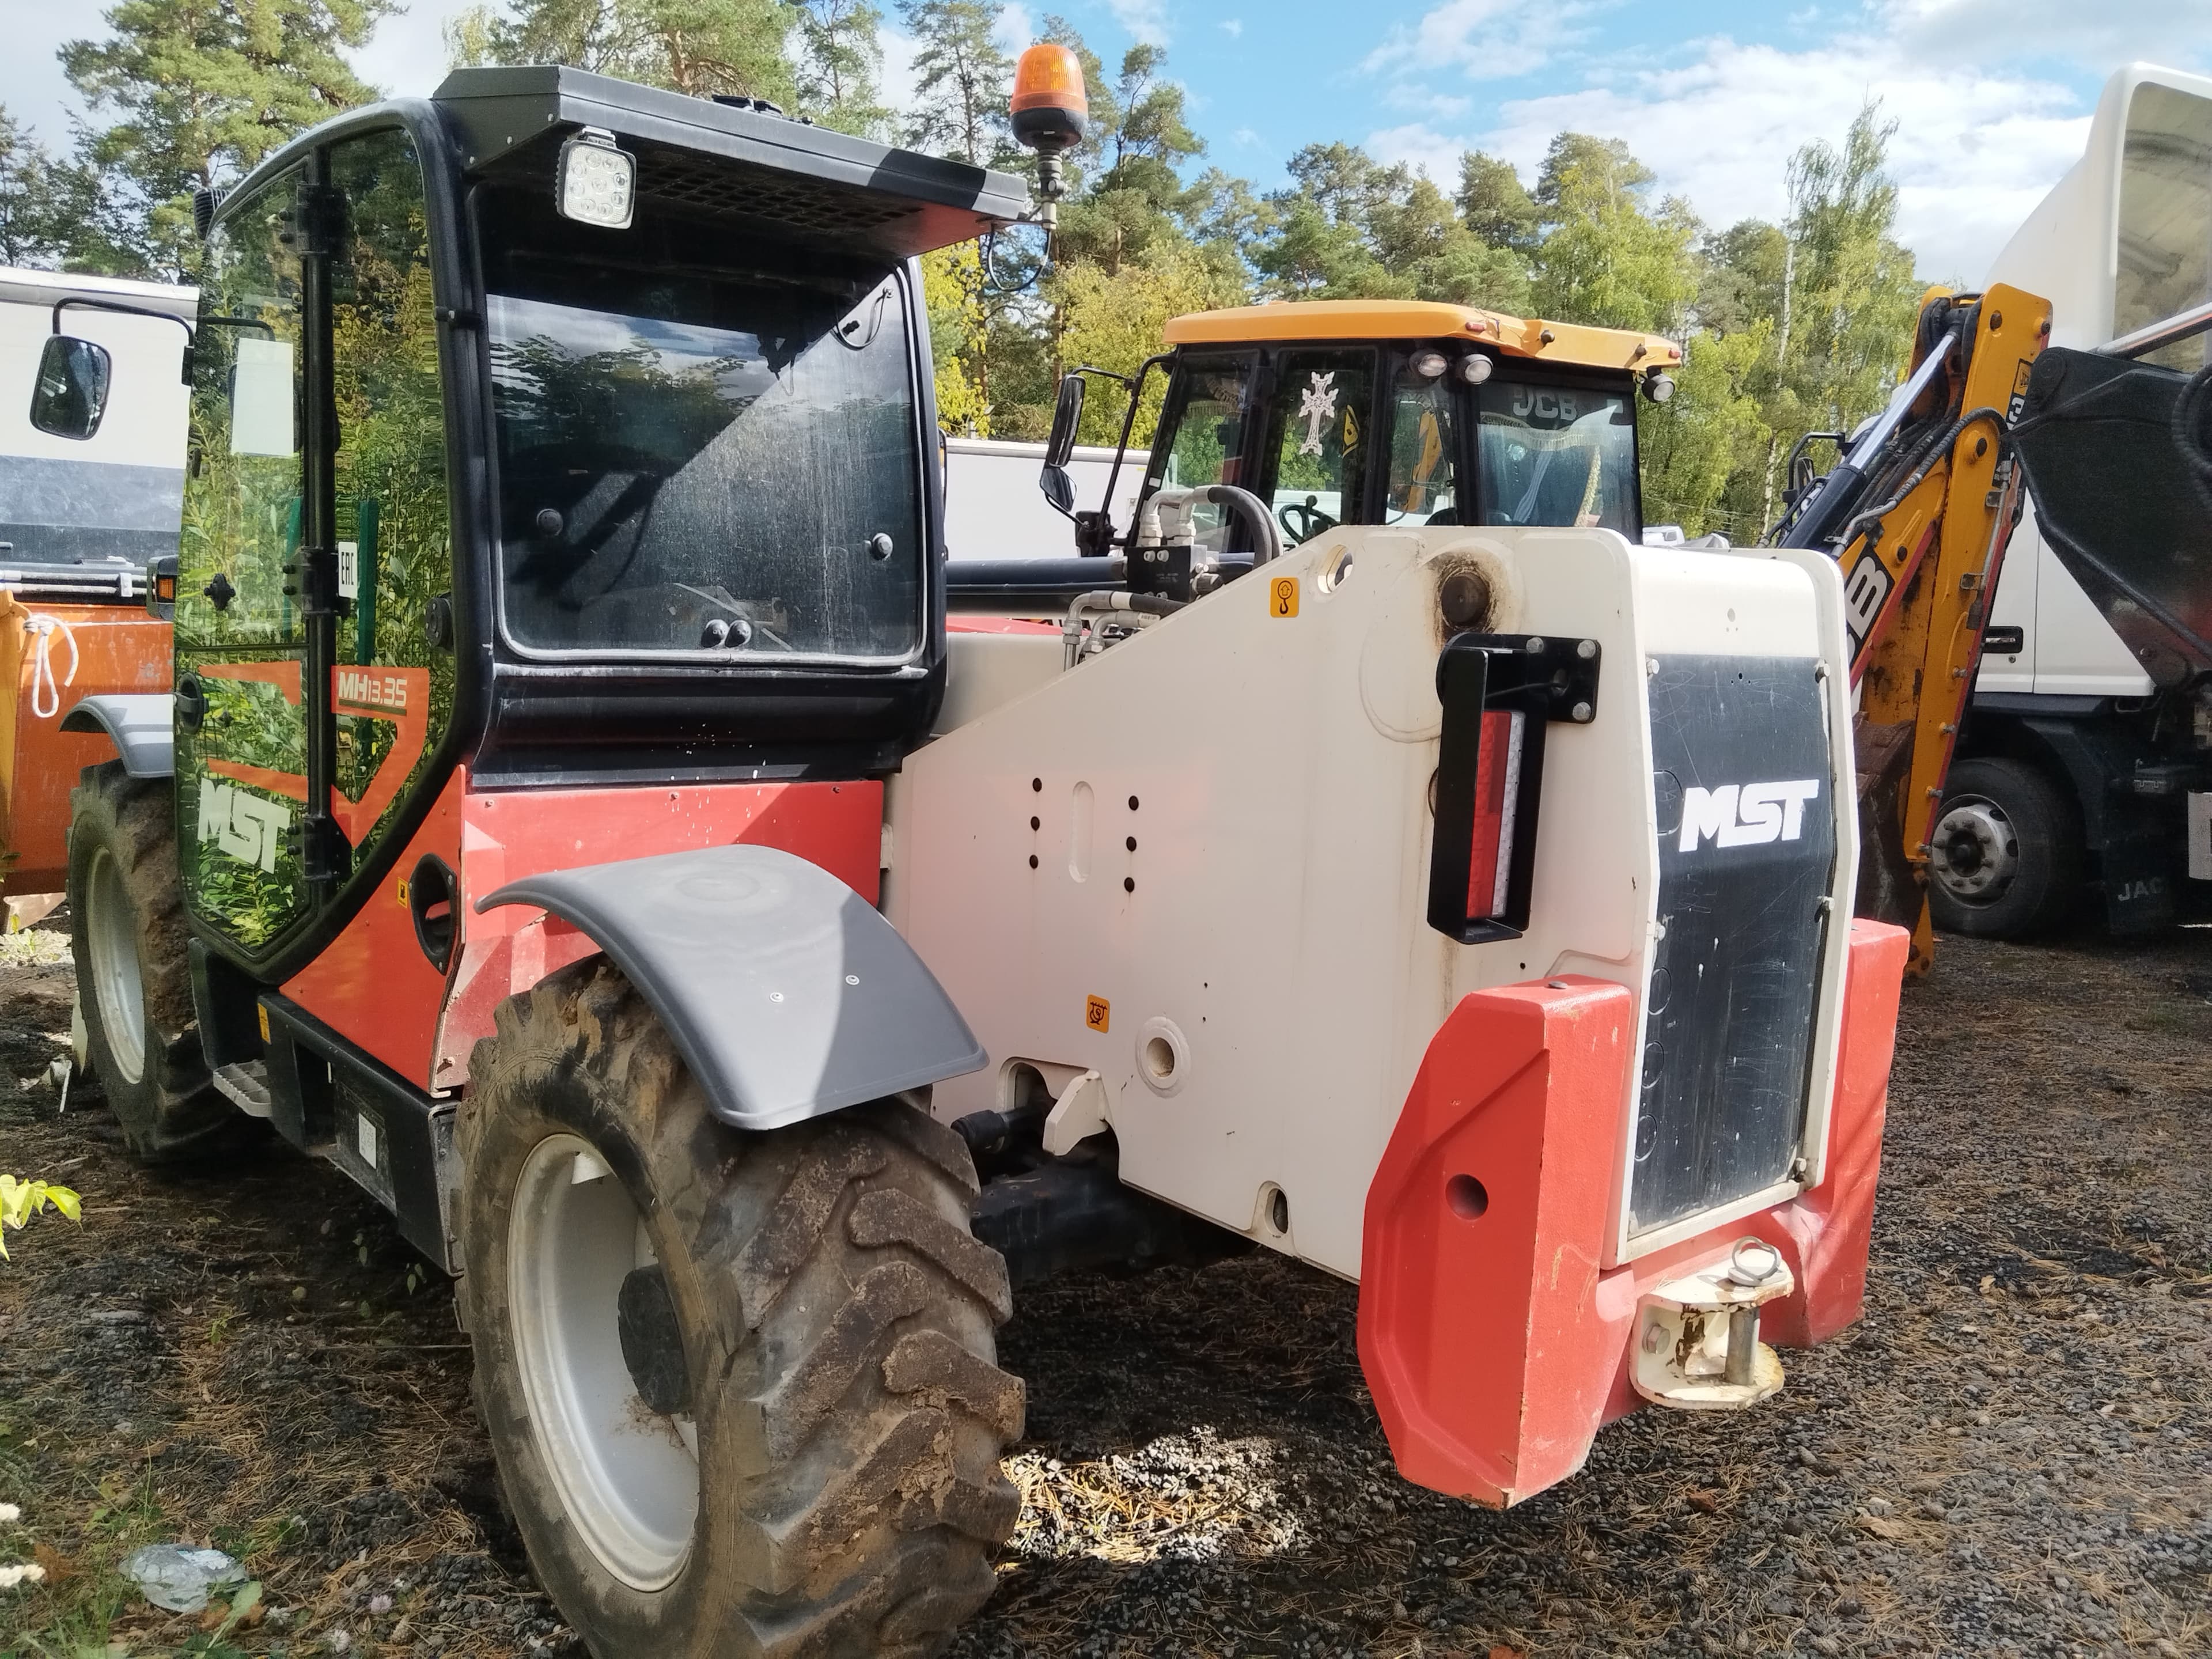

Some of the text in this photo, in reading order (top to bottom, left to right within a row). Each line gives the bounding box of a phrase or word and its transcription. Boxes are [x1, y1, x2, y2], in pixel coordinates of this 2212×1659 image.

[1513, 382, 1578, 421] JCB
[342, 551, 354, 586] EAC
[197, 778, 291, 874] MST
[1679, 779, 1819, 853] MST
